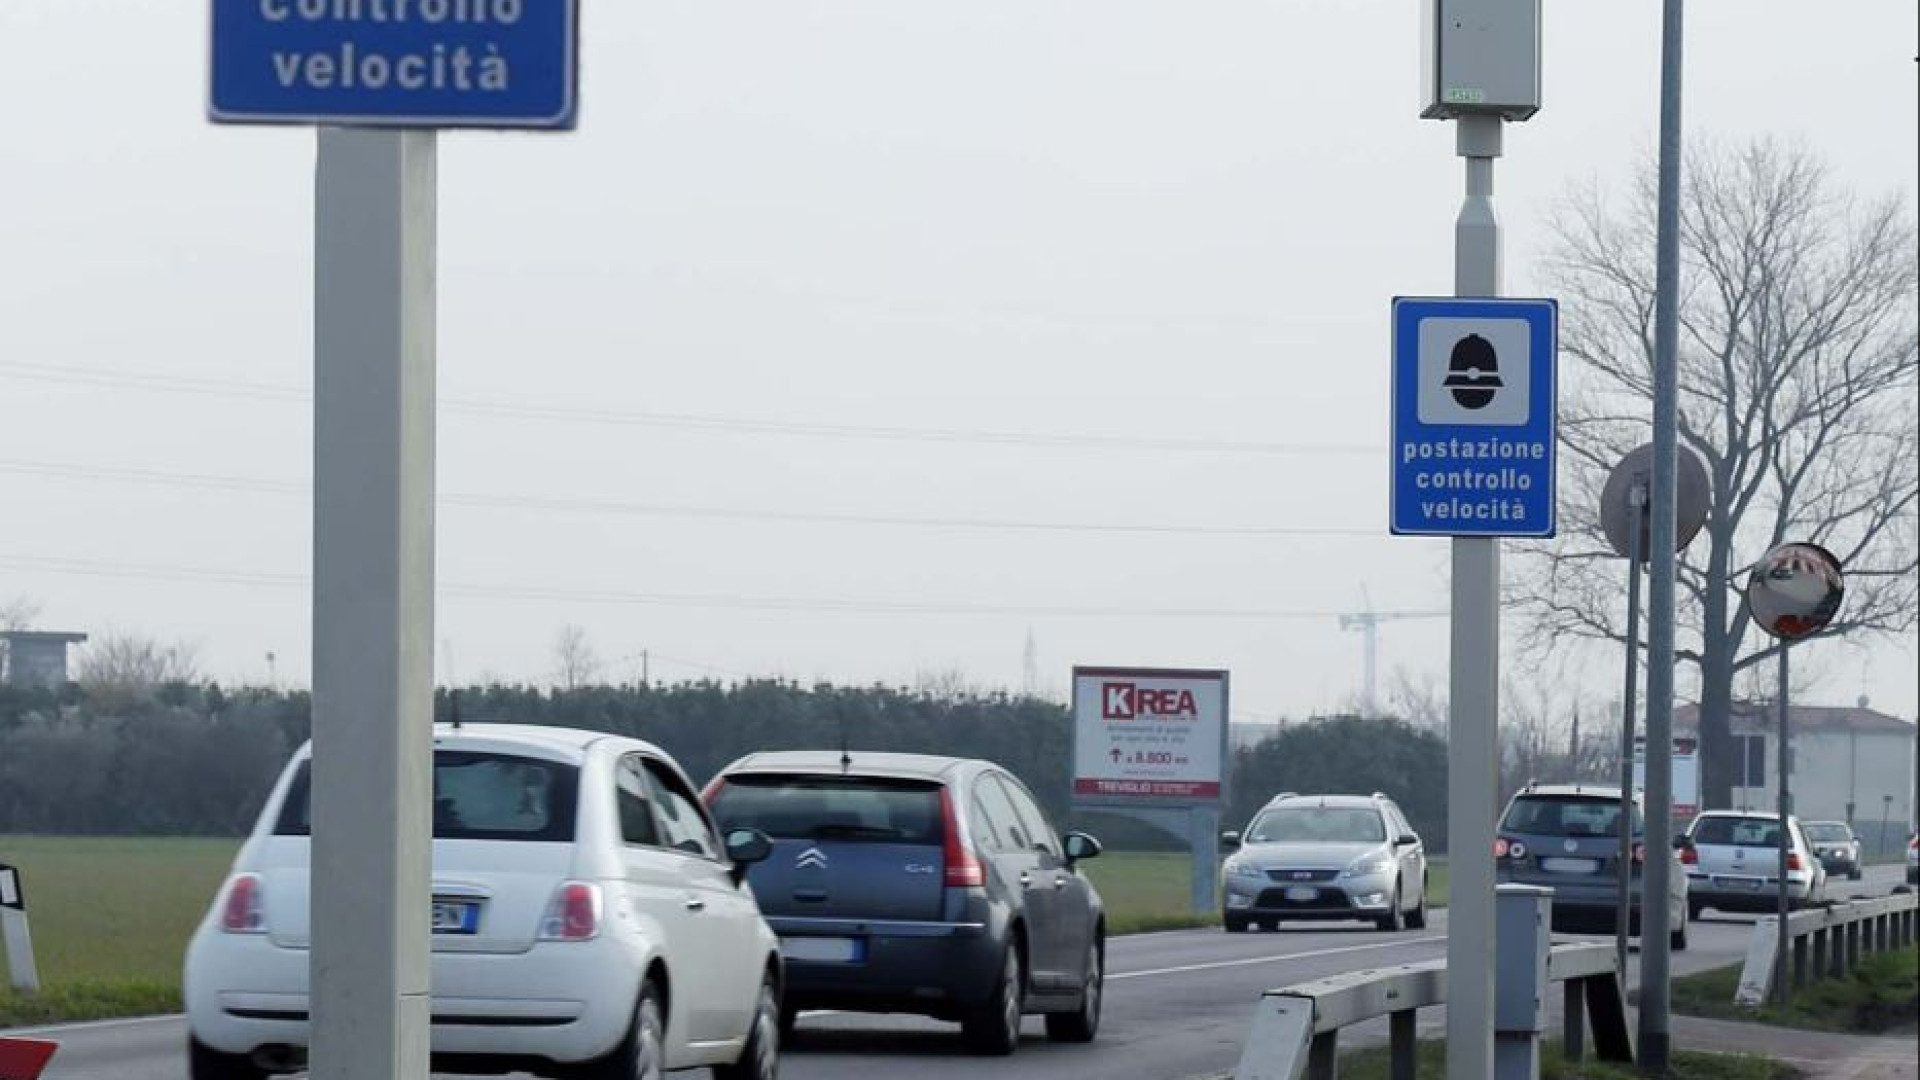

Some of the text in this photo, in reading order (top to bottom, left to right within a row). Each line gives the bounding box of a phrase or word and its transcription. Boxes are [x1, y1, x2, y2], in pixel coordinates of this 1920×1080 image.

[273, 42, 508, 90] velocità
[1404, 438, 1545, 463] postazione
[1415, 468, 1531, 490] controllo
[1421, 497, 1525, 520] velocità
[1104, 684, 1197, 718] KREA
